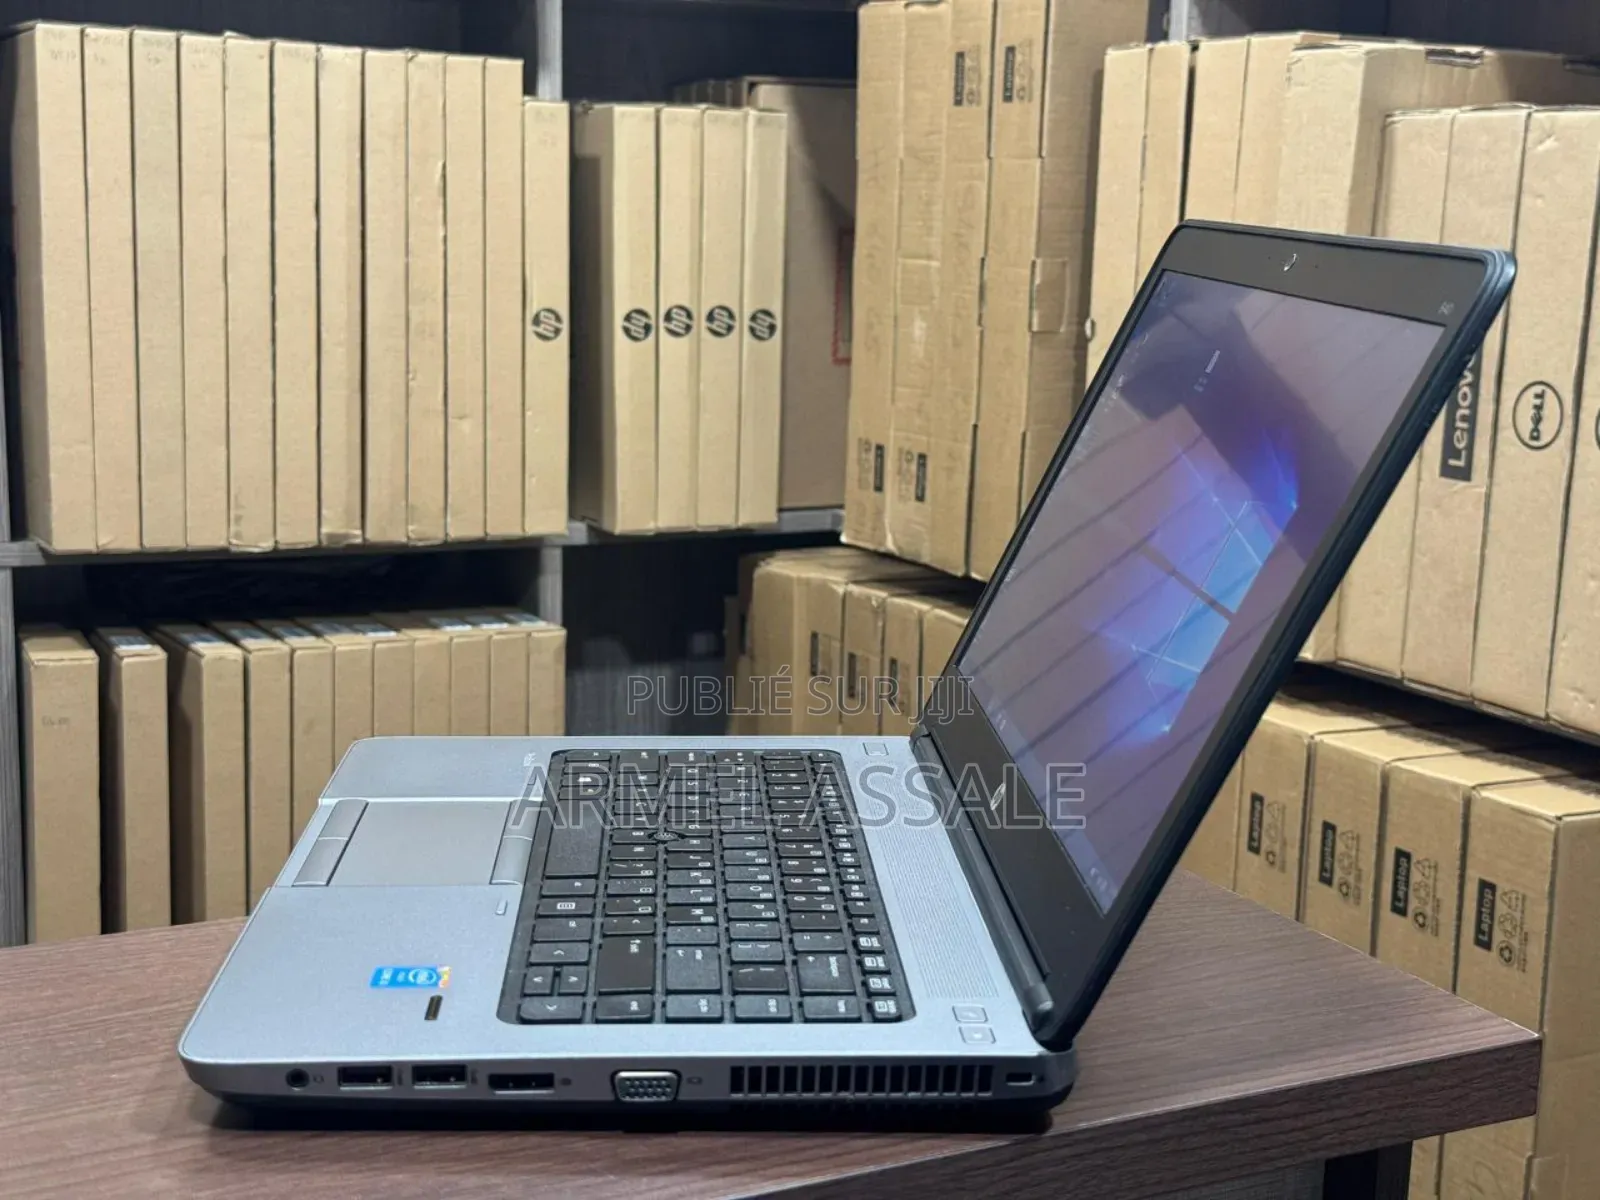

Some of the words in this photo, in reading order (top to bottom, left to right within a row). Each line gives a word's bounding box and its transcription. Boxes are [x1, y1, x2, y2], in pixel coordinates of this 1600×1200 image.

[531, 307, 564, 342] hp
[622, 307, 654, 342] hp
[663, 304, 694, 338] hp
[705, 304, 736, 338] hp
[748, 308, 778, 342] hp
[1528, 388, 1546, 442] DELL
[1394, 856, 1409, 908] Laptop
[1477, 887, 1493, 942] Laptop
